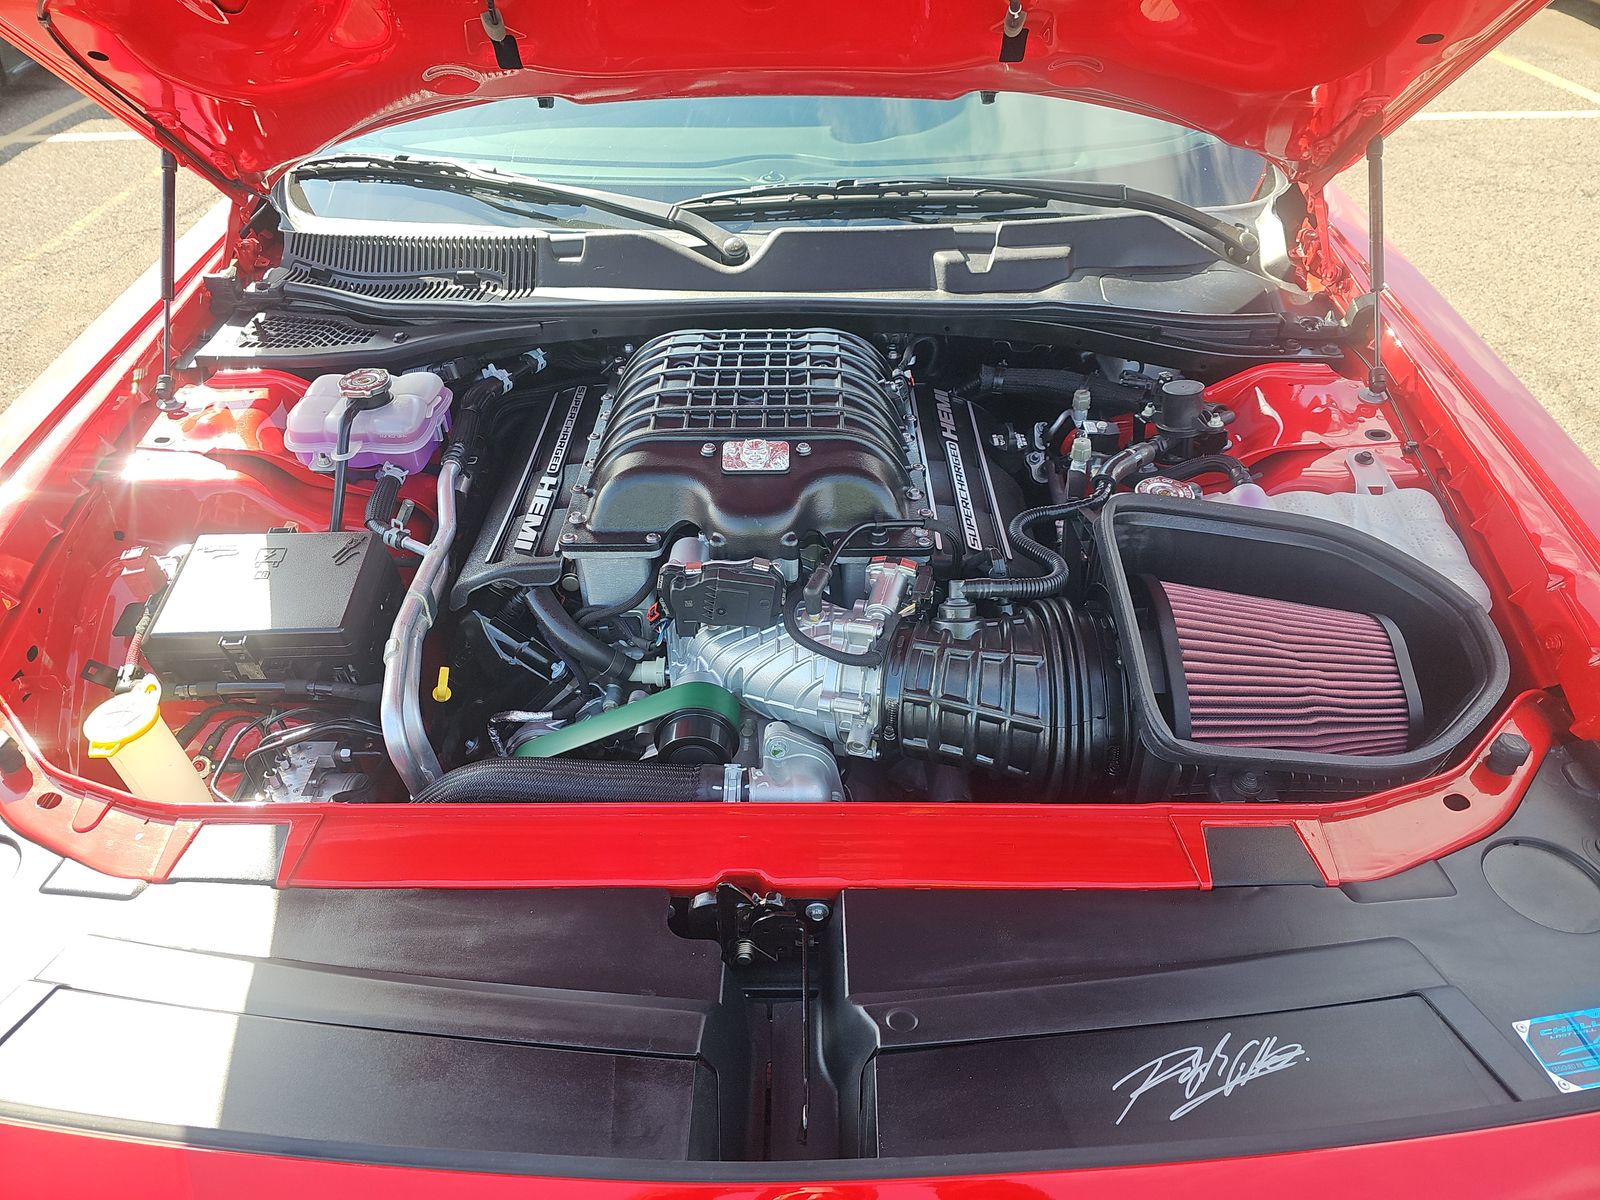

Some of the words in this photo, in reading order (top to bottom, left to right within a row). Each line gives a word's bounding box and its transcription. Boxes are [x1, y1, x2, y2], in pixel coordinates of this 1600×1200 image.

[548, 386, 587, 473] SUPERCHARGED
[934, 389, 959, 442] HEMI
[514, 476, 558, 551] HEMI
[946, 441, 982, 550] SUPERCHARGED
